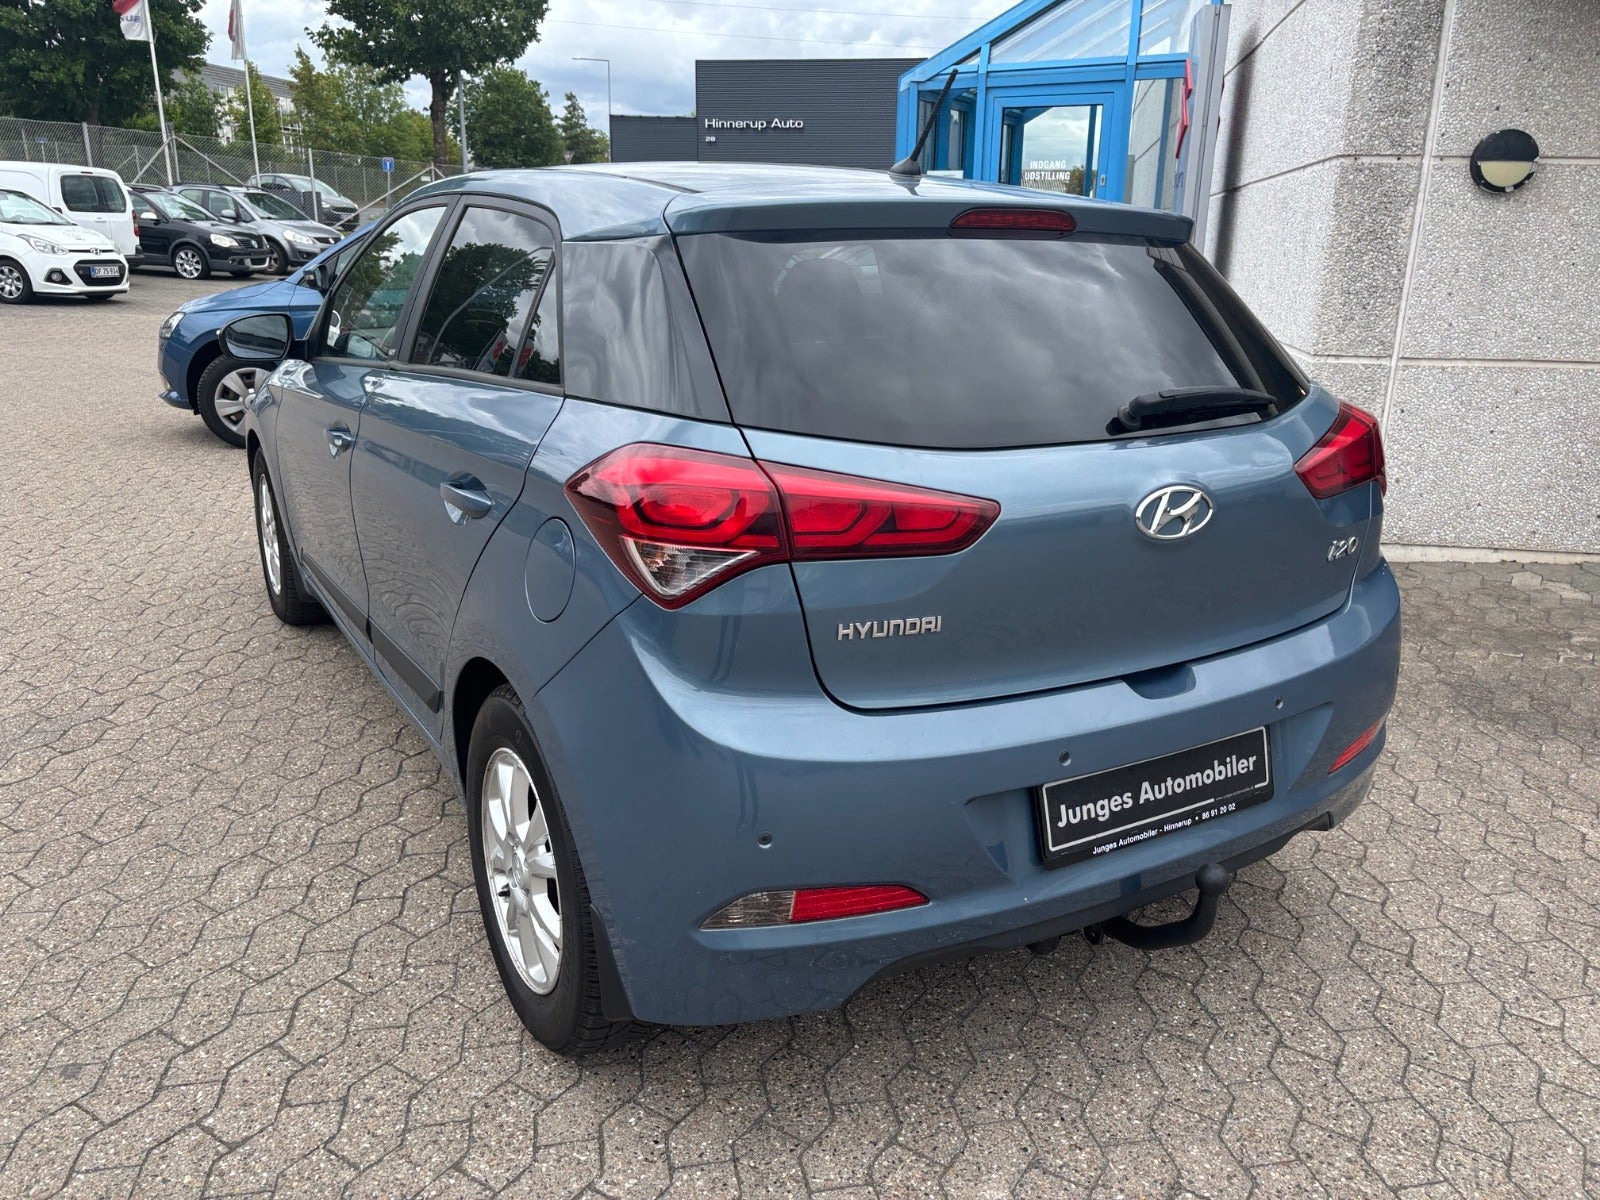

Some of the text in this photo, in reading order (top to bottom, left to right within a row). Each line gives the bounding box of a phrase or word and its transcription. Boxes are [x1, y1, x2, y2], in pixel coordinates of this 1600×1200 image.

[704, 118, 804, 131] Hinnerup Auto
[1024, 171, 1071, 180] UDSTILLING
[1030, 160, 1067, 169] INDGANG
[1328, 536, 1358, 561] i20
[837, 615, 942, 641] HYUNDAI
[1057, 754, 1257, 827] Junges Automobiler
[1092, 841, 1117, 855] Junges
[1118, 829, 1158, 847] Automobiler
[1163, 818, 1192, 832] Hinnerup
[1201, 811, 1210, 820] 86
[1210, 808, 1218, 817] 91
[1219, 805, 1228, 814] 20
[1227, 802, 1236, 811] 02
